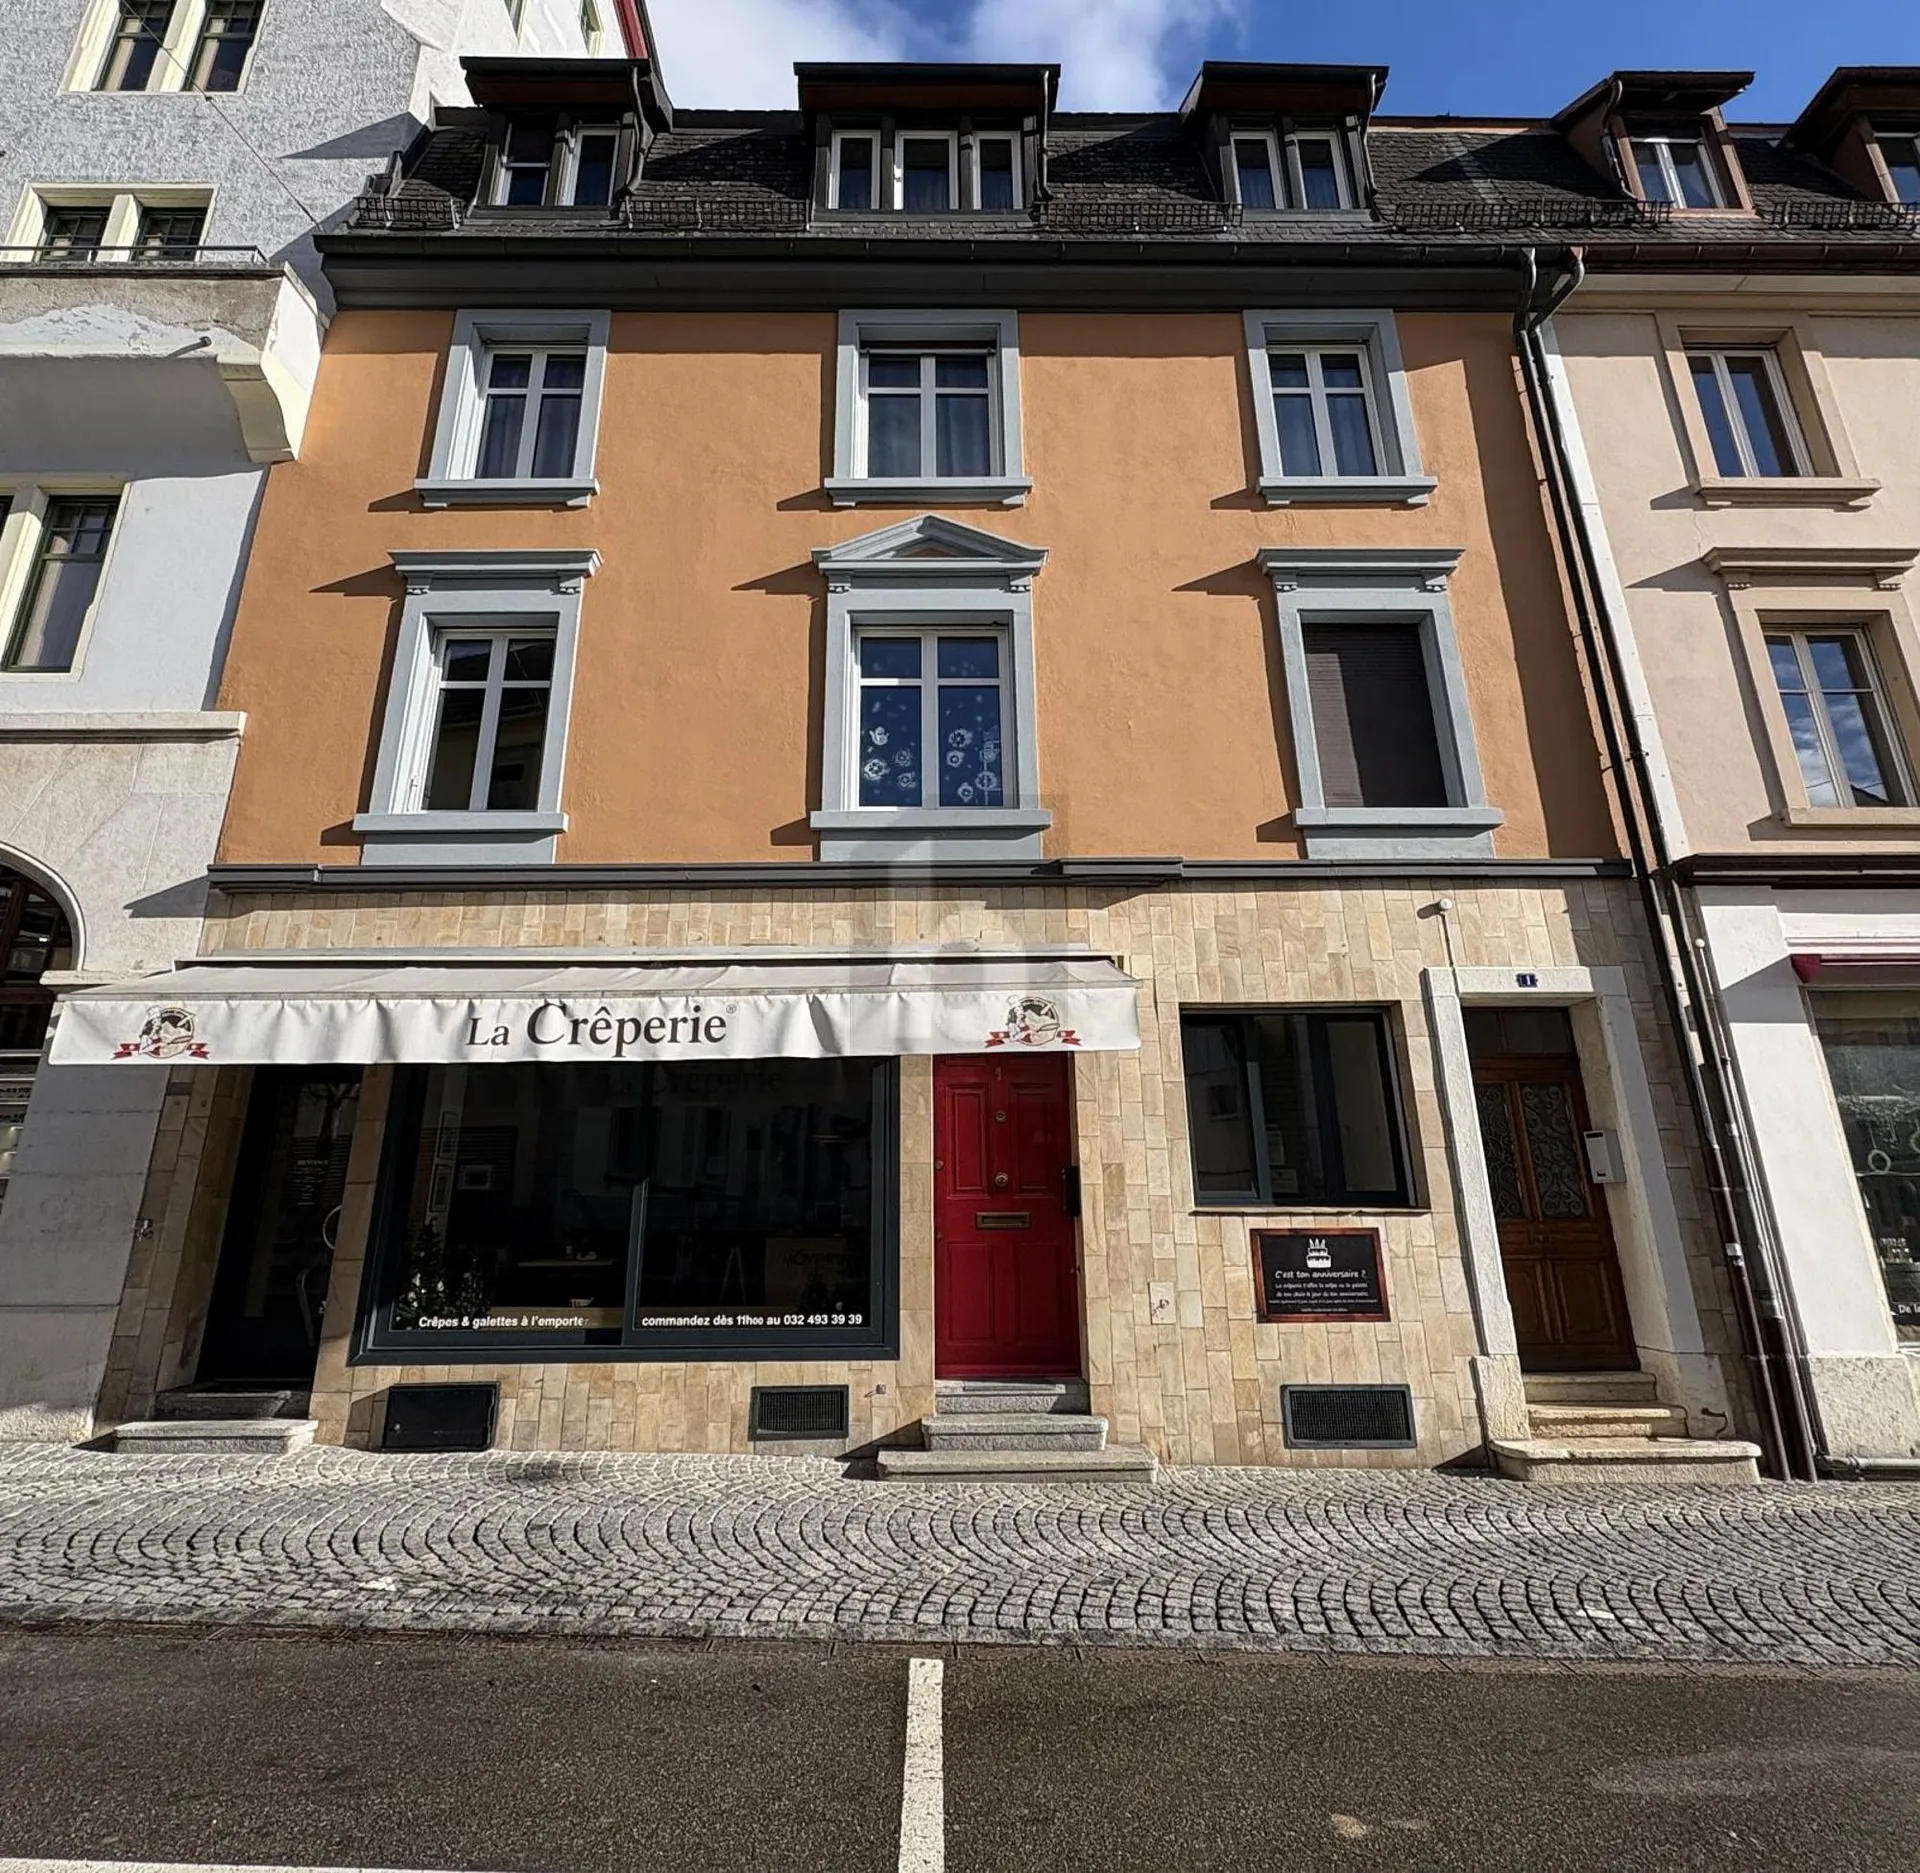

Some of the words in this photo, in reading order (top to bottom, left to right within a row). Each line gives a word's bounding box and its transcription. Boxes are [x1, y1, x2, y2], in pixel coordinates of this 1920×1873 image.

[465, 1017, 510, 1046] La
[1274, 1270, 1294, 1279] C'est
[1296, 1270, 1311, 1279] ton
[1312, 1269, 1359, 1279] anniversaire
[1898, 1304, 1912, 1314] De
[418, 1315, 459, 1329] Crêpes
[461, 1315, 470, 1327] &
[472, 1315, 518, 1330] galettes
[520, 1315, 529, 1327] à
[641, 1314, 710, 1326] commandez
[713, 1314, 734, 1326] dès
[766, 1315, 781, 1326] au
[783, 1314, 805, 1325] 032
[807, 1313, 828, 1325] 493
[831, 1313, 846, 1325] 39
[848, 1313, 863, 1325] 39
